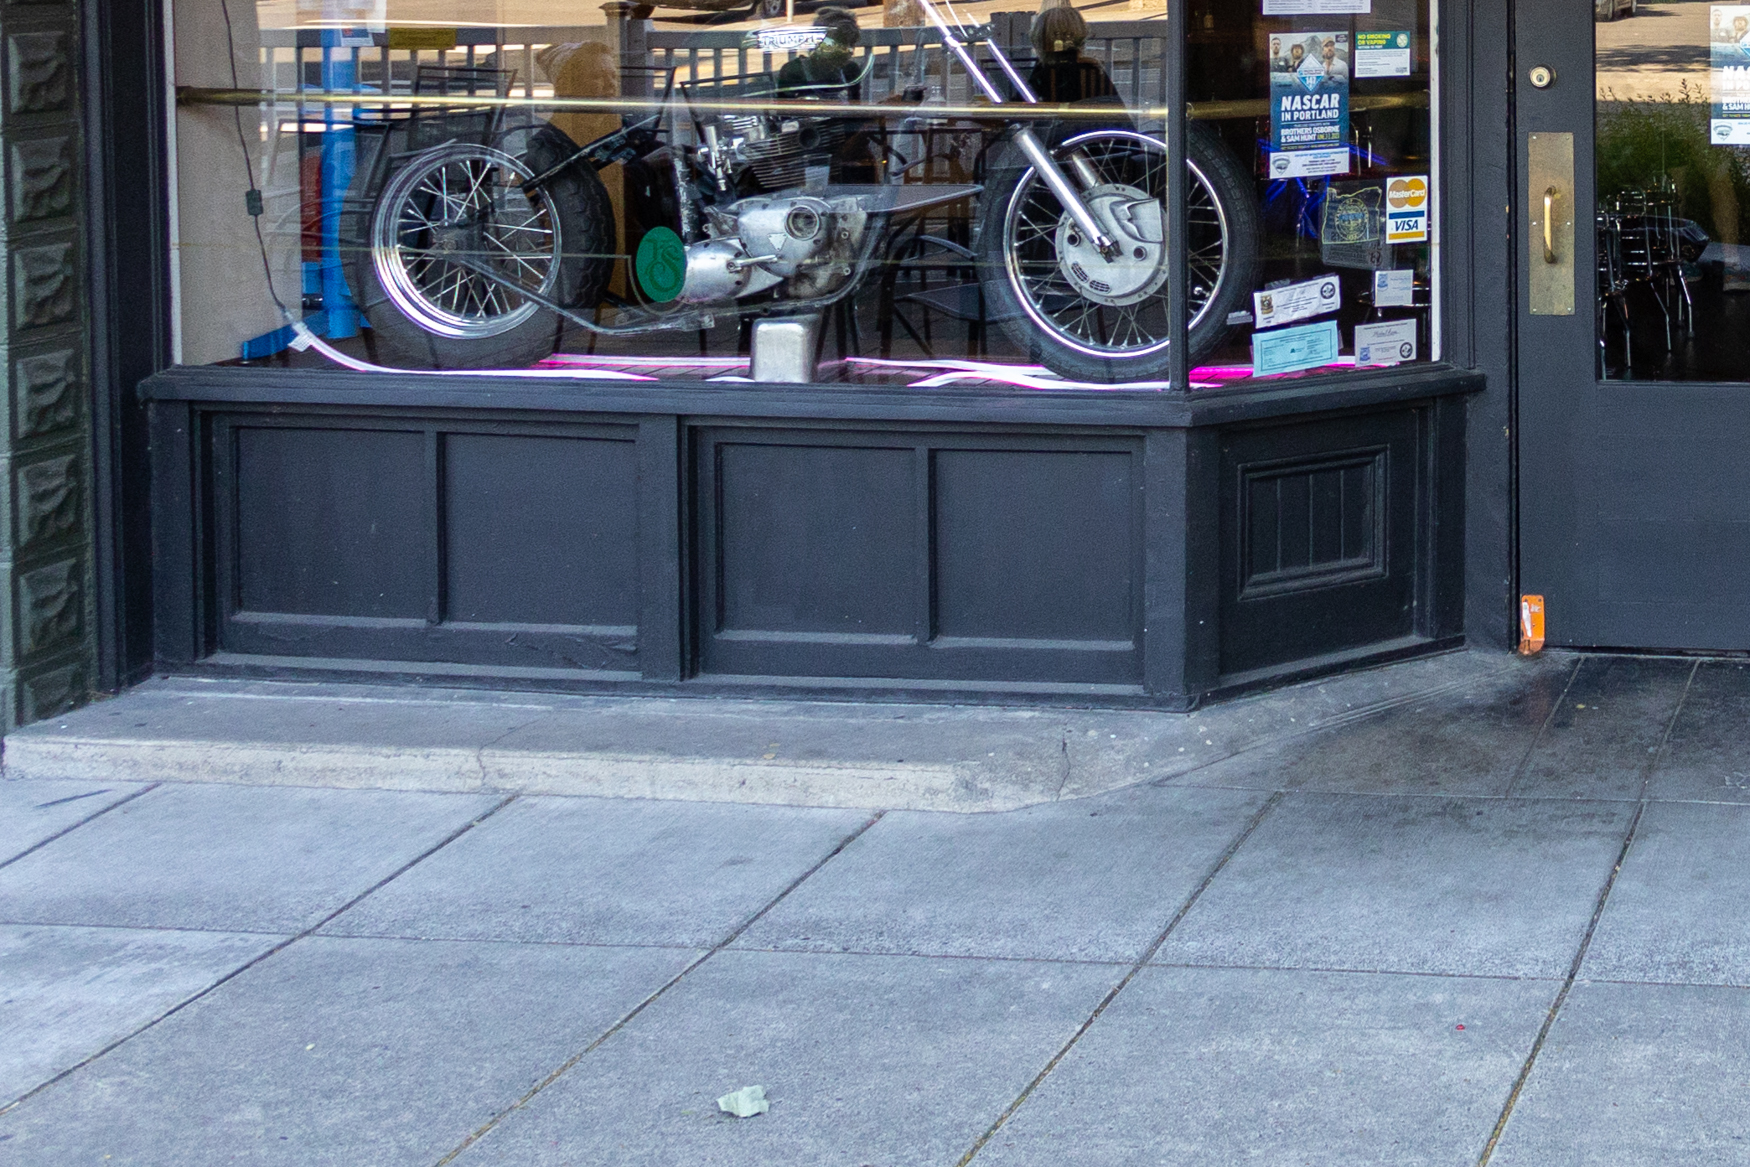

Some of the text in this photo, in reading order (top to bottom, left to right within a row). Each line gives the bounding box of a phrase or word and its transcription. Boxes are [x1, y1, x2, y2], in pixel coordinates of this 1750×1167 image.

[1281, 94, 1340, 111] NASCAR
[1281, 109, 1339, 121] IN PORTLAND
[1388, 189, 1426, 199] MasterCard
[1395, 219, 1419, 231] VISA
